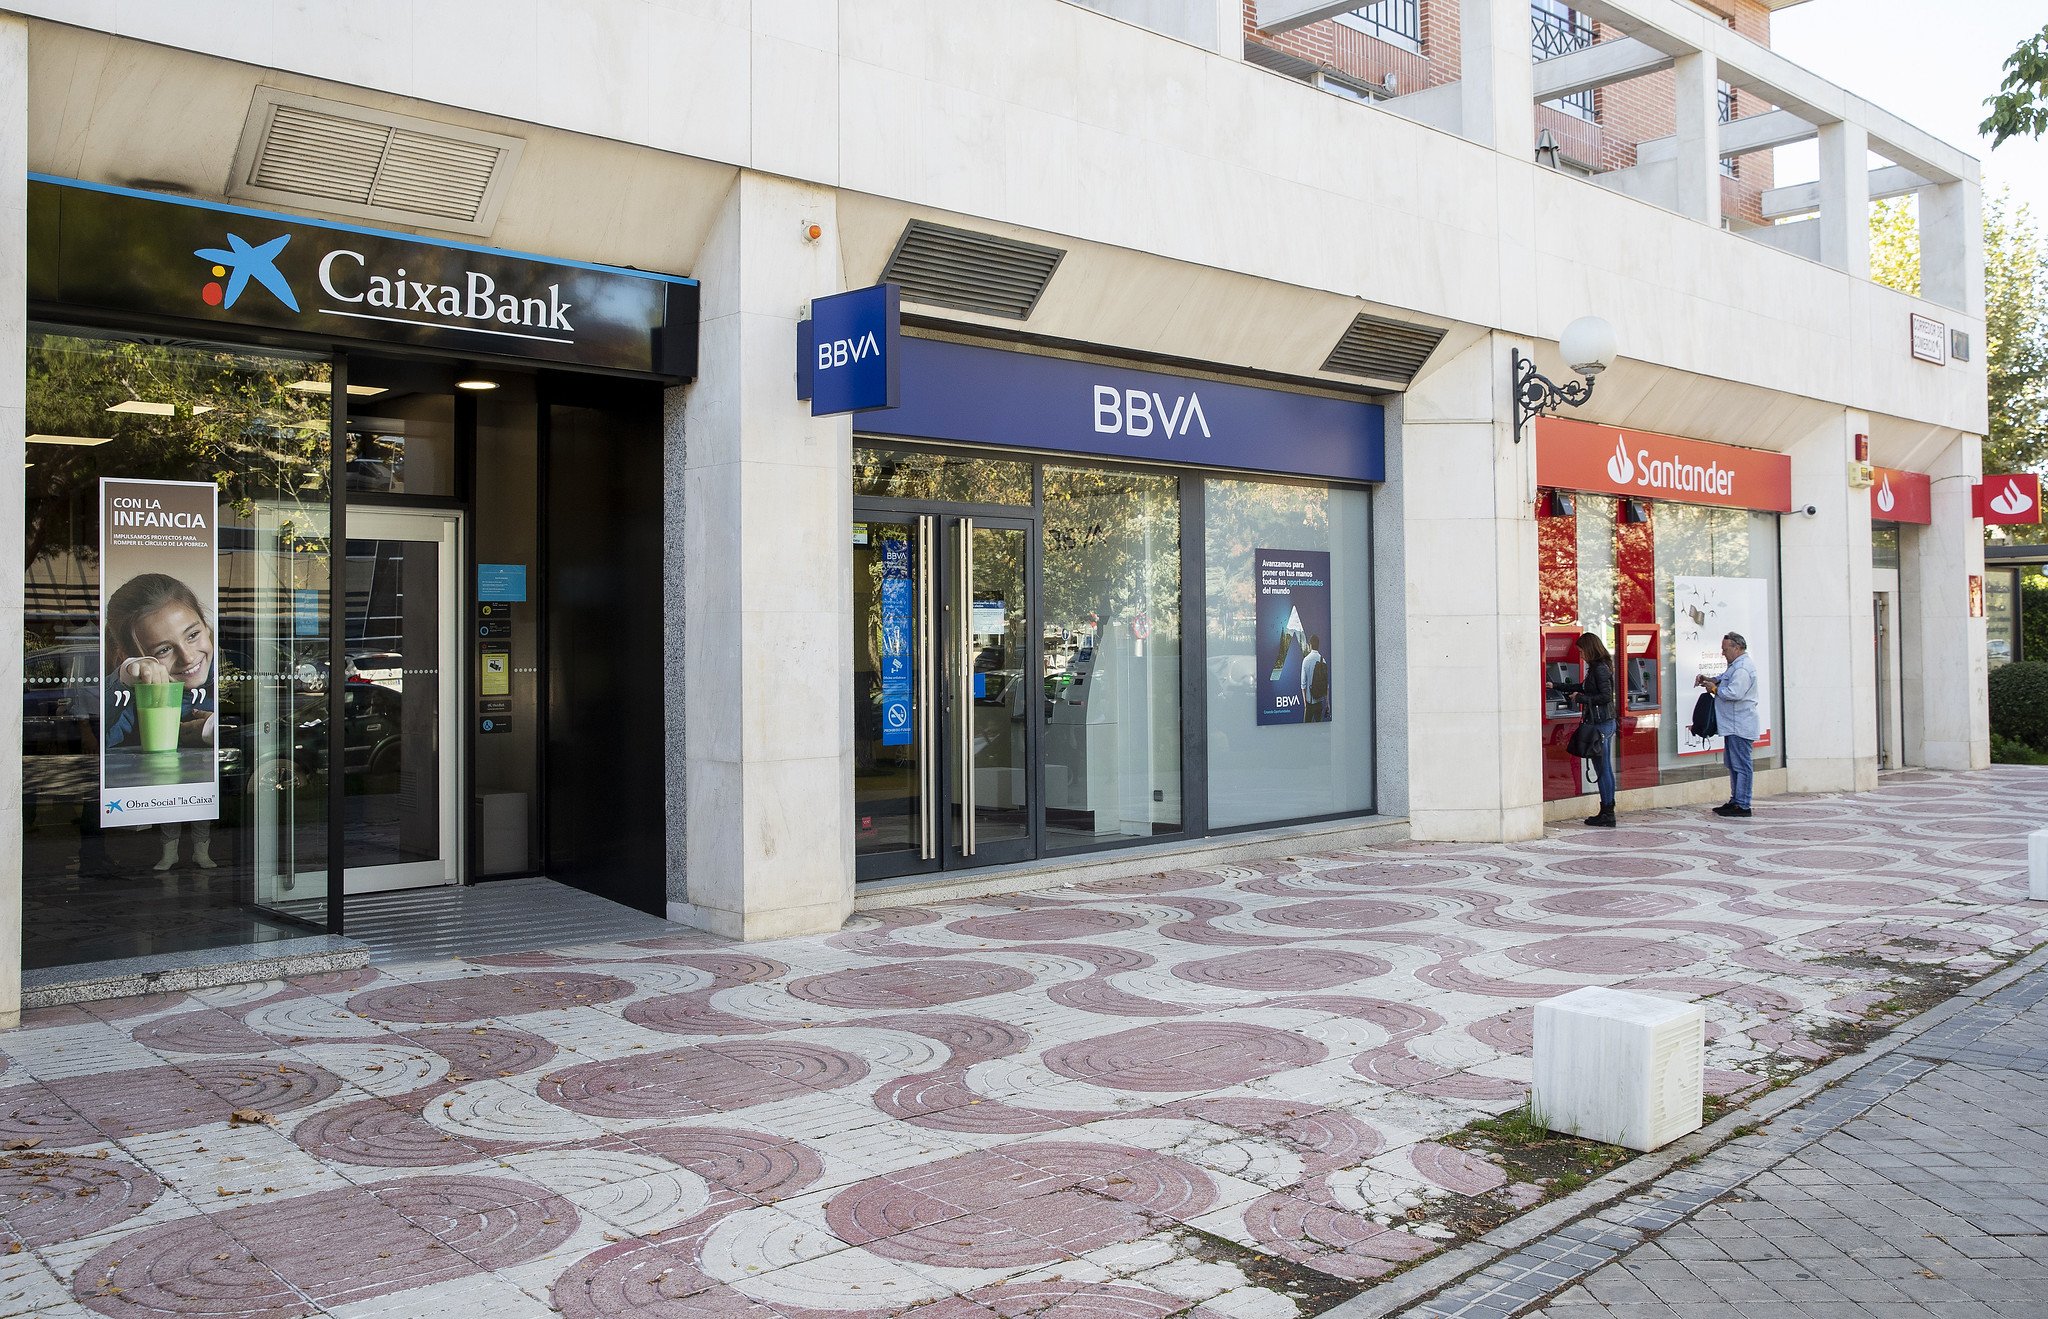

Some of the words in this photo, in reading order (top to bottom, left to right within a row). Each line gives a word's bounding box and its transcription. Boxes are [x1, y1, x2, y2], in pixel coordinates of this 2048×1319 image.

[318, 249, 575, 332] CaixaBank
[818, 330, 880, 370] BBVA
[1093, 384, 1212, 440] BBVA
[1637, 449, 1735, 496] Santander
[113, 497, 141, 508] CON
[145, 499, 161, 509] LA
[114, 511, 206, 528] INFANCIA
[886, 552, 907, 560] BBVA
[1262, 559, 1291, 568] Avanzamos
[1262, 578, 1277, 586] todas
[1278, 578, 1286, 586] las
[1286, 579, 1324, 587] oportunidades
[1271, 587, 1291, 595] mundo
[1276, 695, 1300, 708] BBVA
[126, 800, 149, 809] Obra
[150, 797, 176, 808] Social
[178, 796, 188, 805] "la
[188, 794, 216, 805] Caixa"
